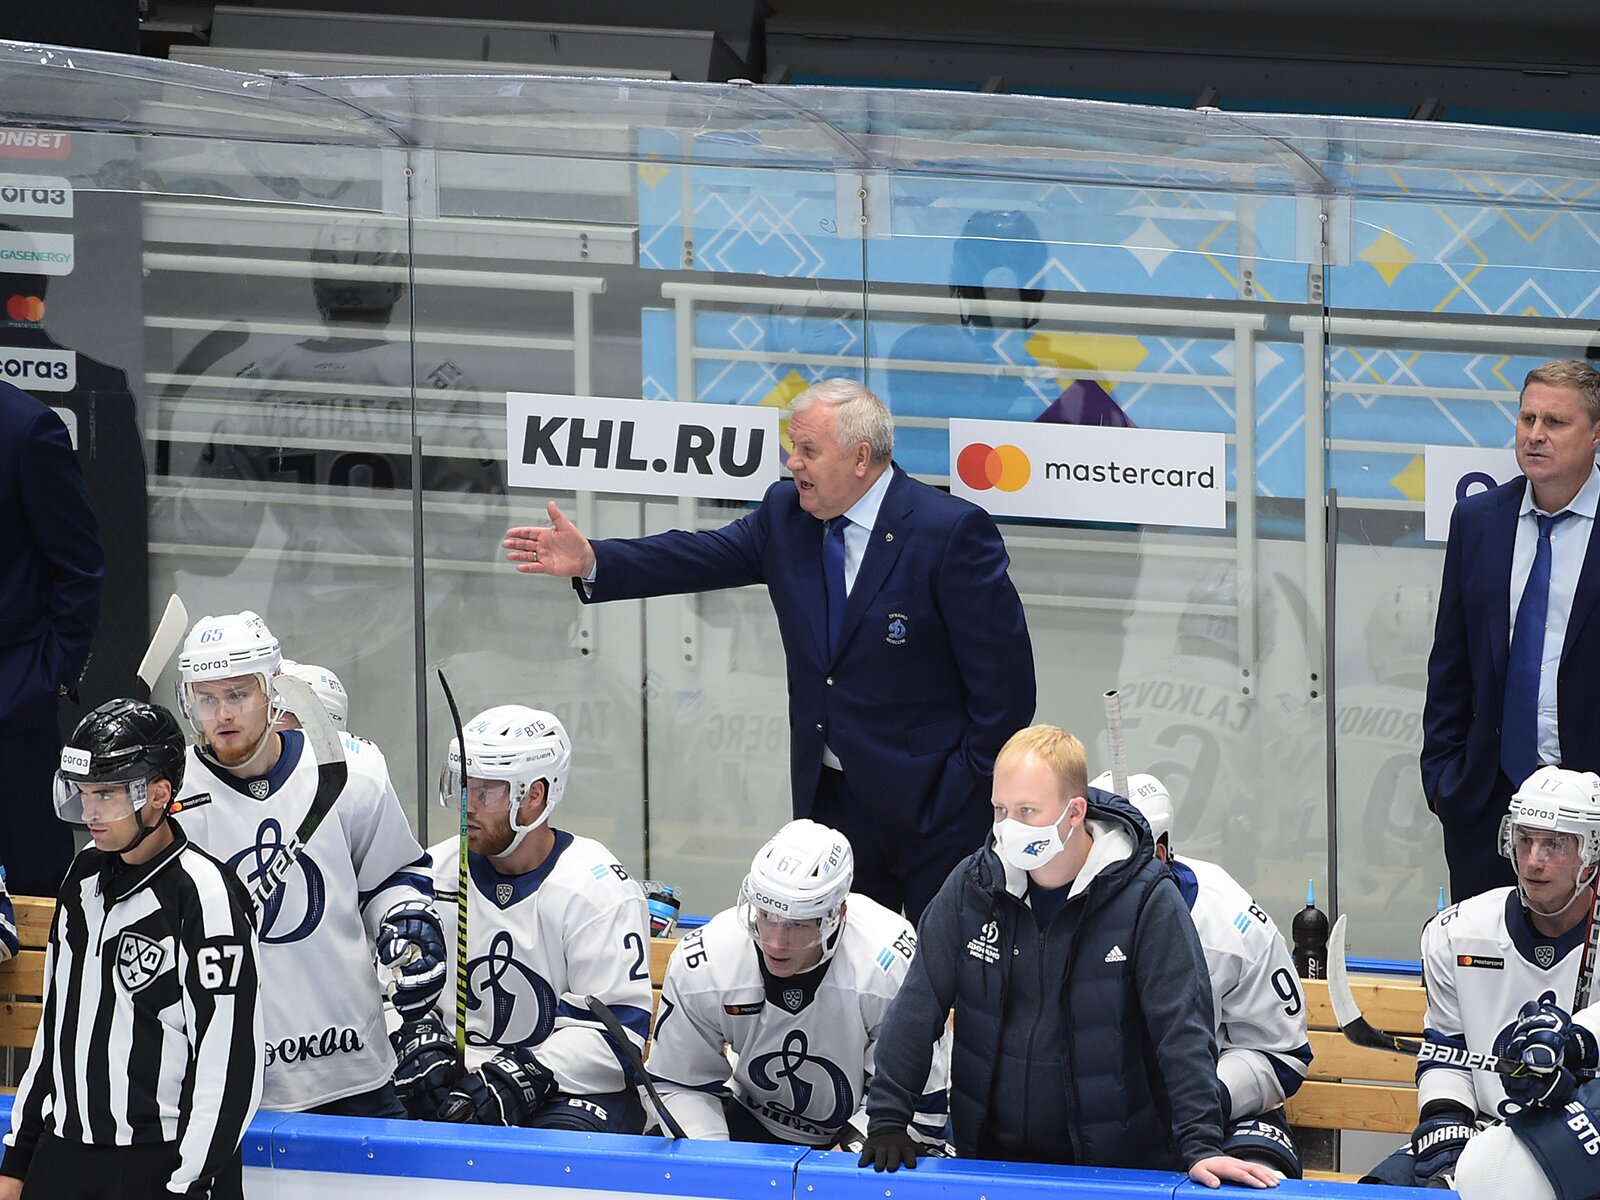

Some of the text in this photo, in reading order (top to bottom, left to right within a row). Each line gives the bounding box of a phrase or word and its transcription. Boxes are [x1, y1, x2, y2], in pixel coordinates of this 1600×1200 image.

[0, 187, 66, 205] огаз
[0, 358, 68, 380] огаз
[522, 415, 765, 478] KHL.RU
[1045, 461, 1215, 489] mastercard
[200, 628, 224, 643] 65
[524, 720, 546, 737] ВТБ
[1136, 783, 1157, 798] ВТБ
[777, 855, 802, 875] 67
[828, 843, 842, 867] ВТБ
[197, 945, 244, 990] 67
[1104, 955, 1128, 963] adidas
[265, 1026, 364, 1067] осква
[568, 1098, 608, 1121] ВТБ
[1567, 1113, 1600, 1156] ВТБ
